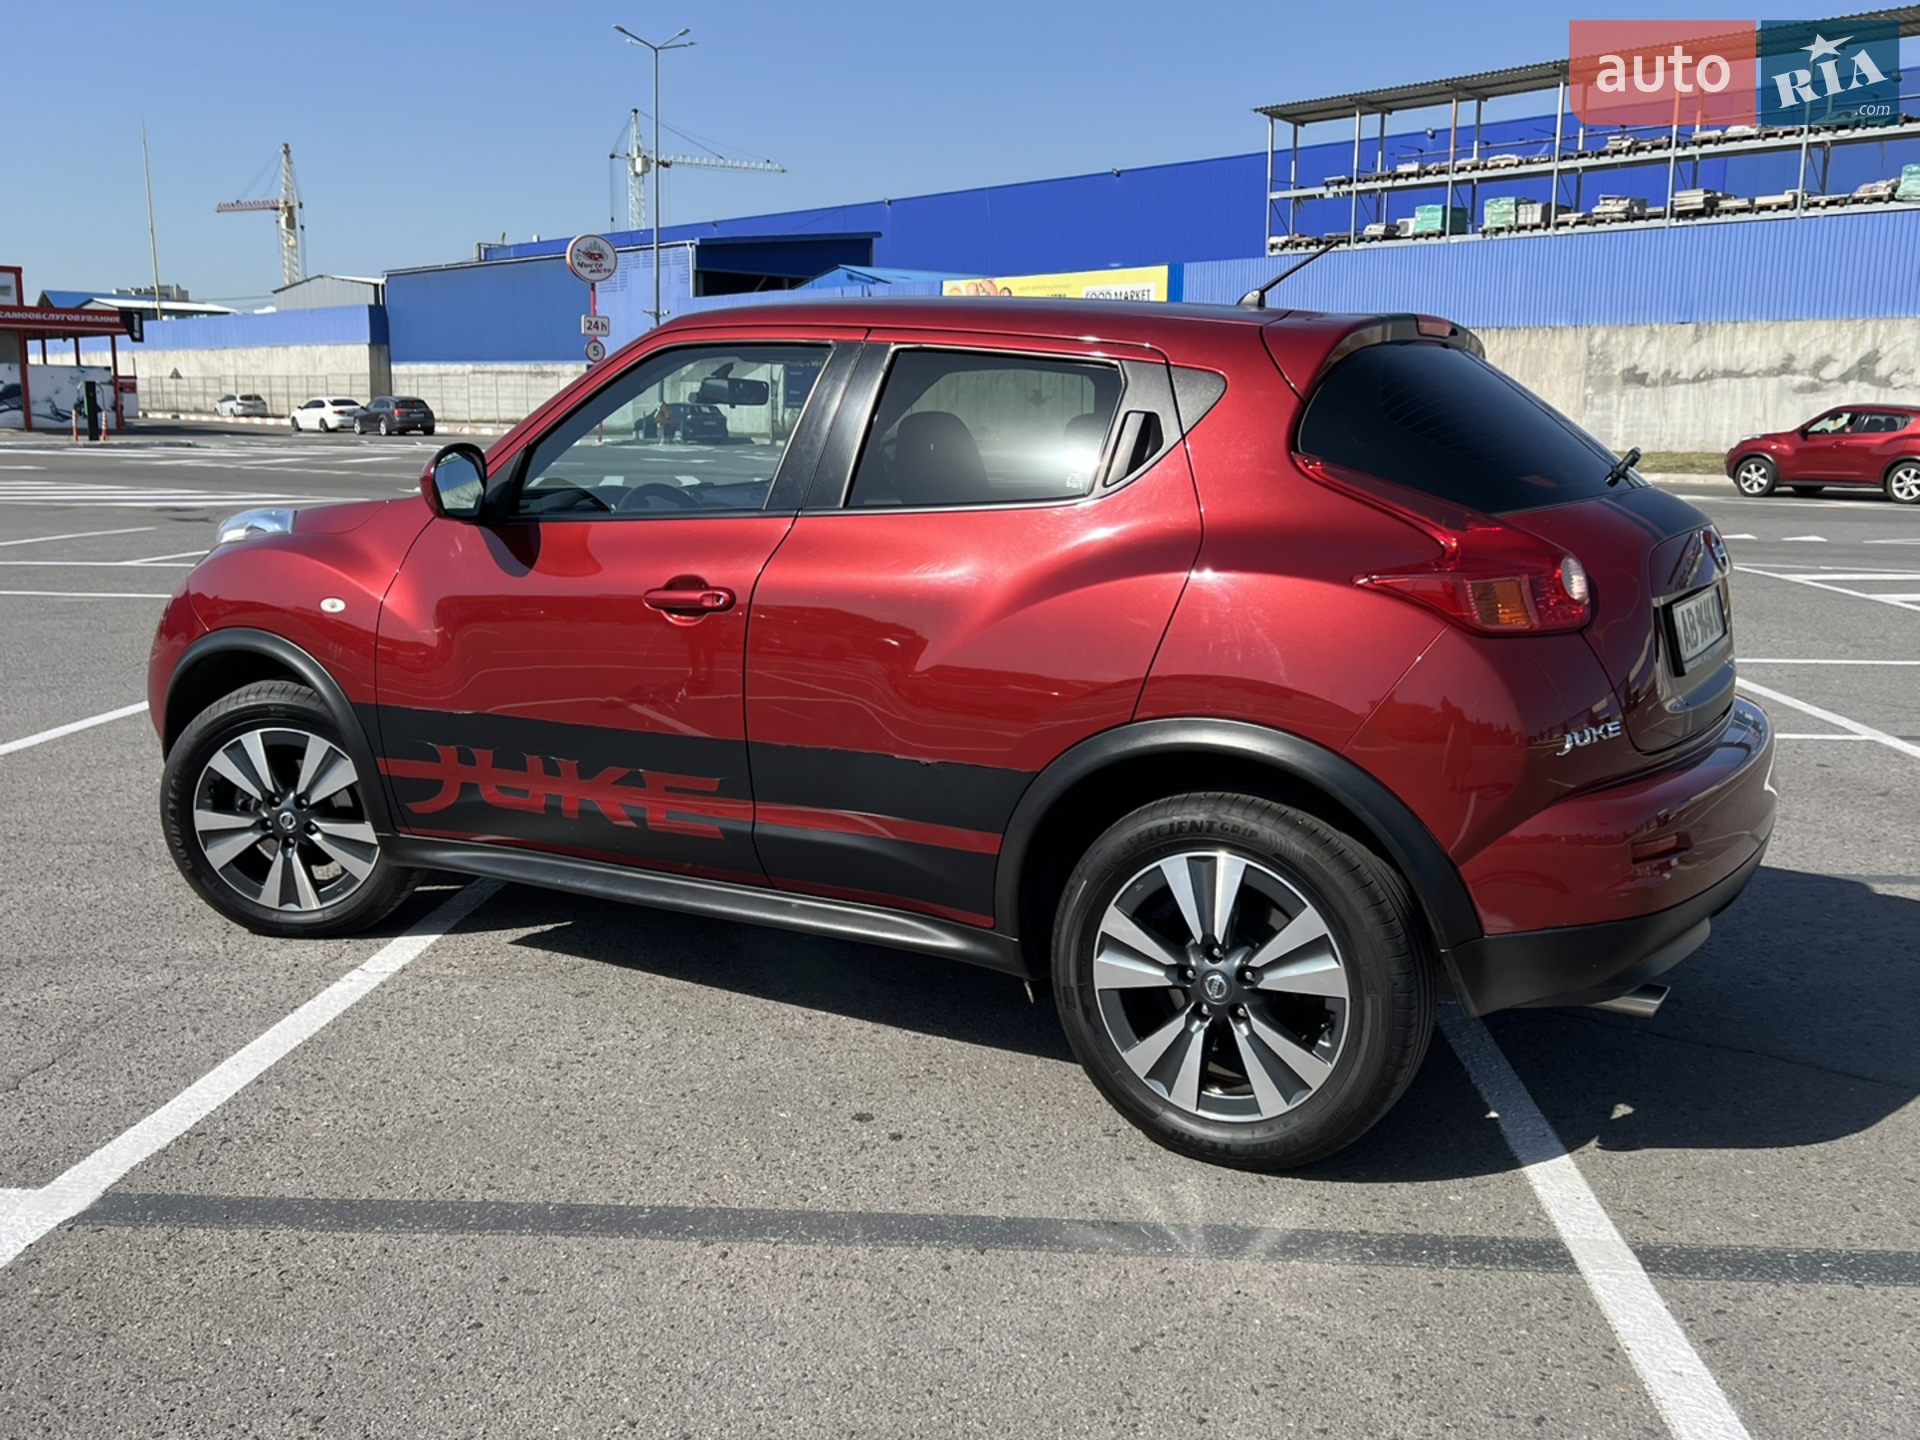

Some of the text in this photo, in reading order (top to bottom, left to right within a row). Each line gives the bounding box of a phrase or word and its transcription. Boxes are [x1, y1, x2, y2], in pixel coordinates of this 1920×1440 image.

[1114, 289, 1151, 301] MARKET
[592, 345, 600, 356] 5
[1556, 721, 1622, 756] JUKE
[404, 743, 725, 840] JUKE
